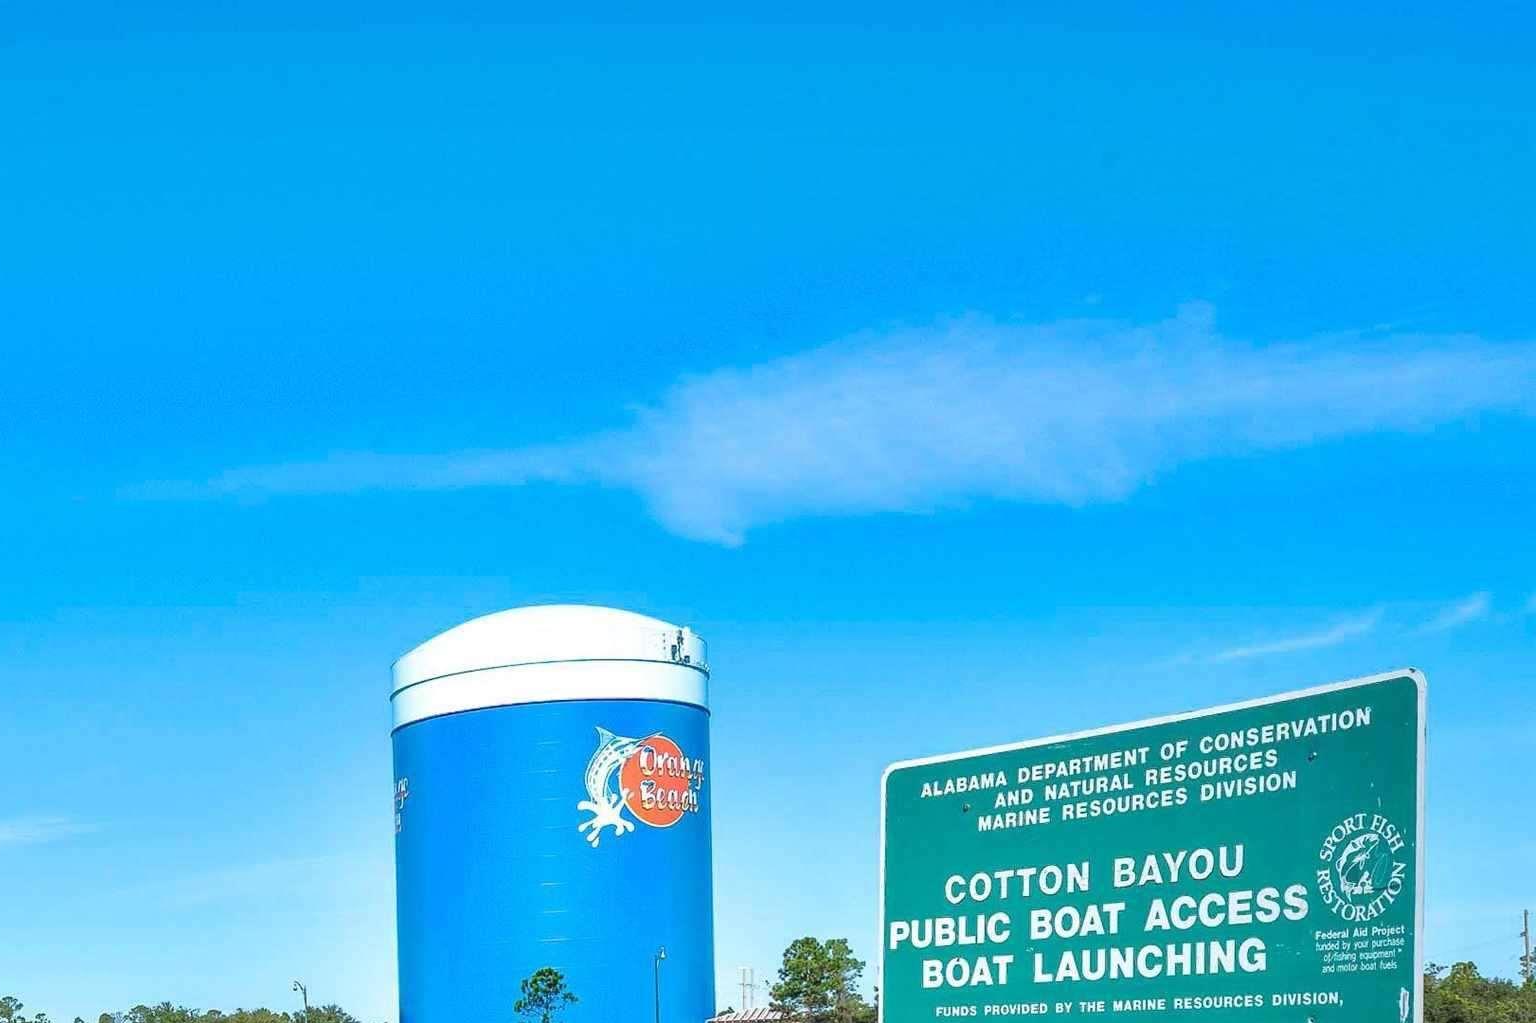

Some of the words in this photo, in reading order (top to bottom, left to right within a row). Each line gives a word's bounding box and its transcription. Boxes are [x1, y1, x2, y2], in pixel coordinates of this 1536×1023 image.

[920, 771, 1008, 798] ALABAMA
[1018, 747, 1149, 783] DEPARTMENT
[1161, 740, 1188, 760] OF
[1199, 707, 1371, 754] CONSERVATION
[640, 779, 699, 812] Beach
[978, 807, 1050, 832] MARINE
[1062, 788, 1188, 820] RESOURCES
[1200, 771, 1297, 801] DIVISION
[994, 788, 1033, 808] AND
[1045, 773, 1134, 801] NATURAL
[1145, 749, 1278, 786] RESOURCES
[1320, 813, 1367, 862] SPORT
[1370, 814, 1405, 853] FISH
[944, 862, 1089, 904] COTTON
[1113, 844, 1244, 888] BAYOU
[1317, 861, 1406, 921] RESTORATION
[890, 912, 1011, 949] PUBLIC
[1030, 902, 1125, 940] BOAT
[1144, 884, 1309, 932] ACCESS
[1315, 928, 1349, 940] Federal
[1353, 928, 1368, 937] Aid
[1372, 925, 1405, 937] Project
[922, 955, 1013, 988] BOAT
[1034, 937, 1267, 983] LAUNCHING
[1315, 940, 1339, 952] funded
[1342, 940, 1351, 953] by
[1354, 941, 1369, 950] your
[1372, 937, 1405, 949] purchase
[1322, 964, 1335, 973] and
[935, 1006, 977, 1016] FUNDS
[984, 1003, 1048, 1016] PROVIDED
[1055, 1002, 1072, 1013] BY
[1079, 1001, 1105, 1013] THE
[1113, 999, 1166, 1012] MARINE
[1174, 995, 1263, 1009] RESOURCES
[1272, 992, 1344, 1006] DIVISION,
